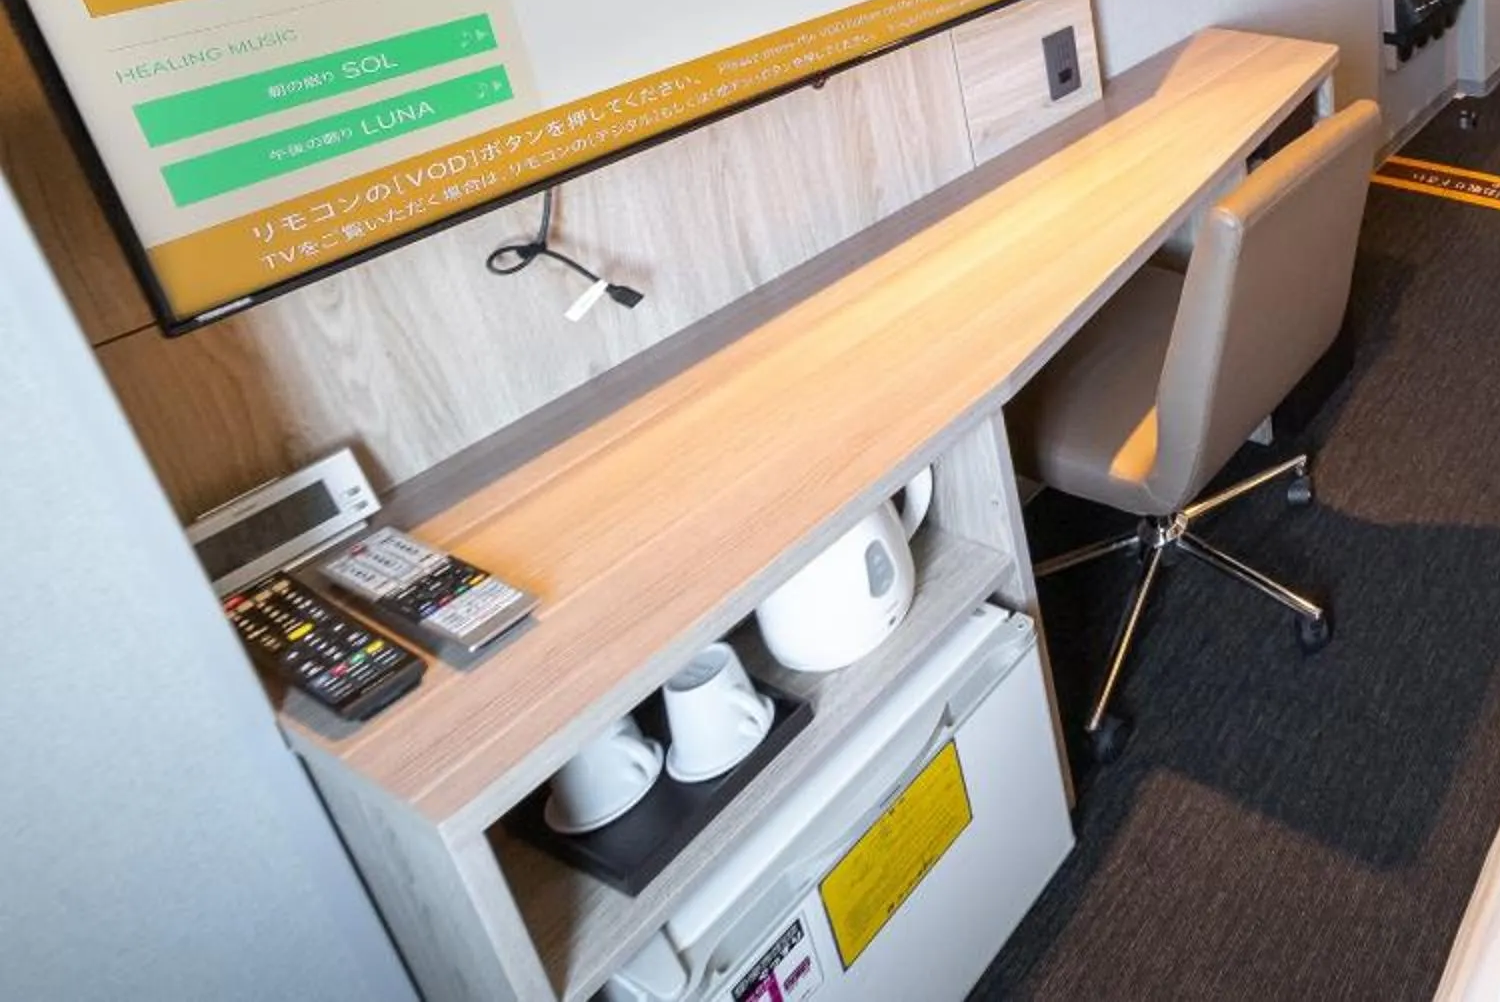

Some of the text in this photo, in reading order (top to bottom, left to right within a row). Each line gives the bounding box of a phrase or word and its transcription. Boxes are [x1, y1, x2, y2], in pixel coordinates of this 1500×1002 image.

[114, 27, 298, 85] HEALING MUSIC
[341, 53, 399, 79] SOL
[361, 101, 436, 135] LUNA
